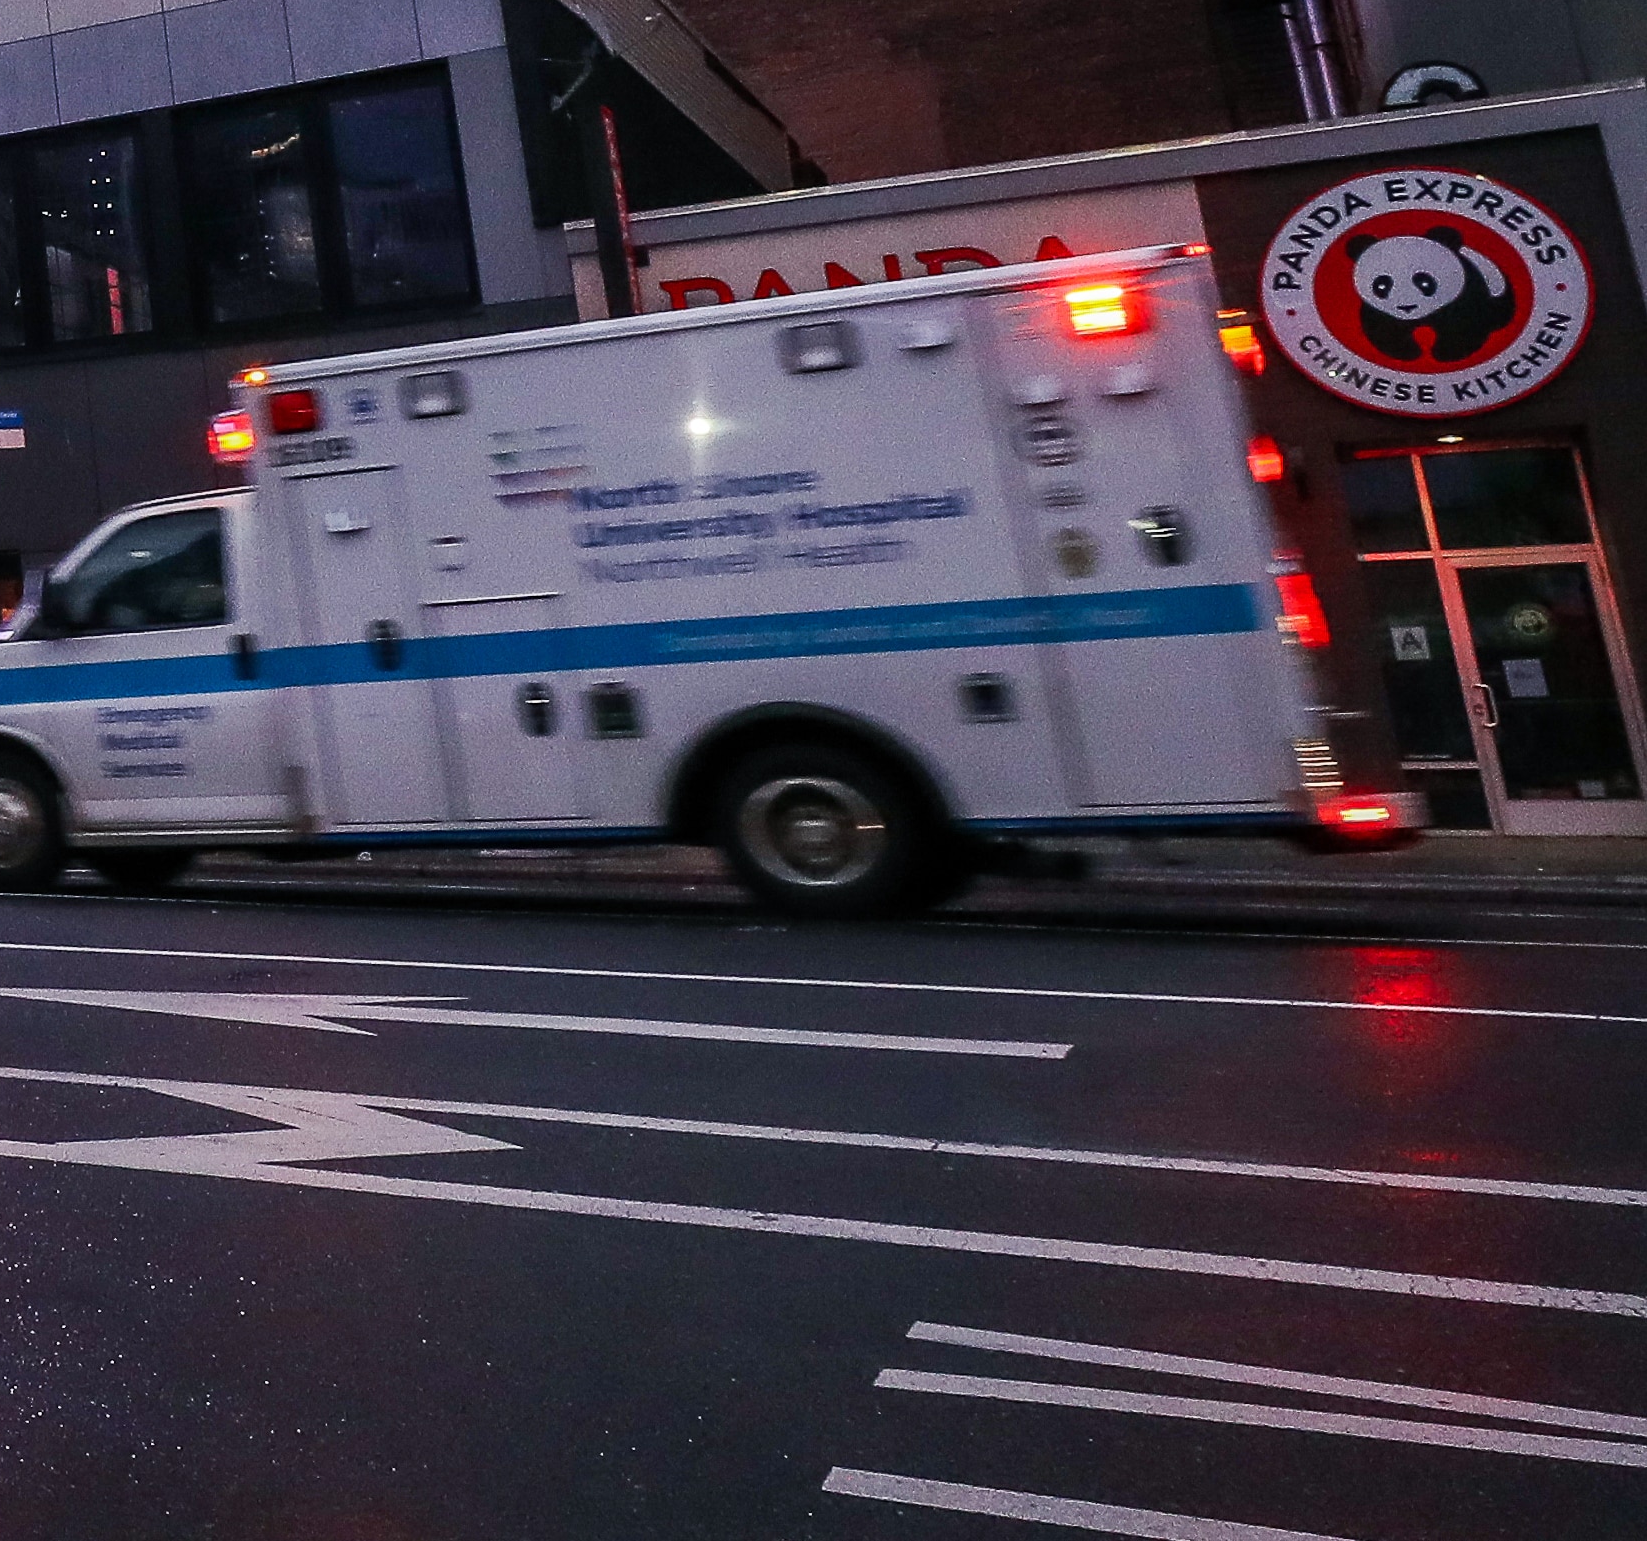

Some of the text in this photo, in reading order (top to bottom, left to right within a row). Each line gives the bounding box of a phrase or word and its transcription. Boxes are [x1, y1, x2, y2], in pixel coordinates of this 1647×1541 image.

[1272, 178, 1567, 292] PANDA EXPRESS
[1299, 311, 1572, 404] CHINESE KITCHEN
[793, 490, 971, 527] Hospital
